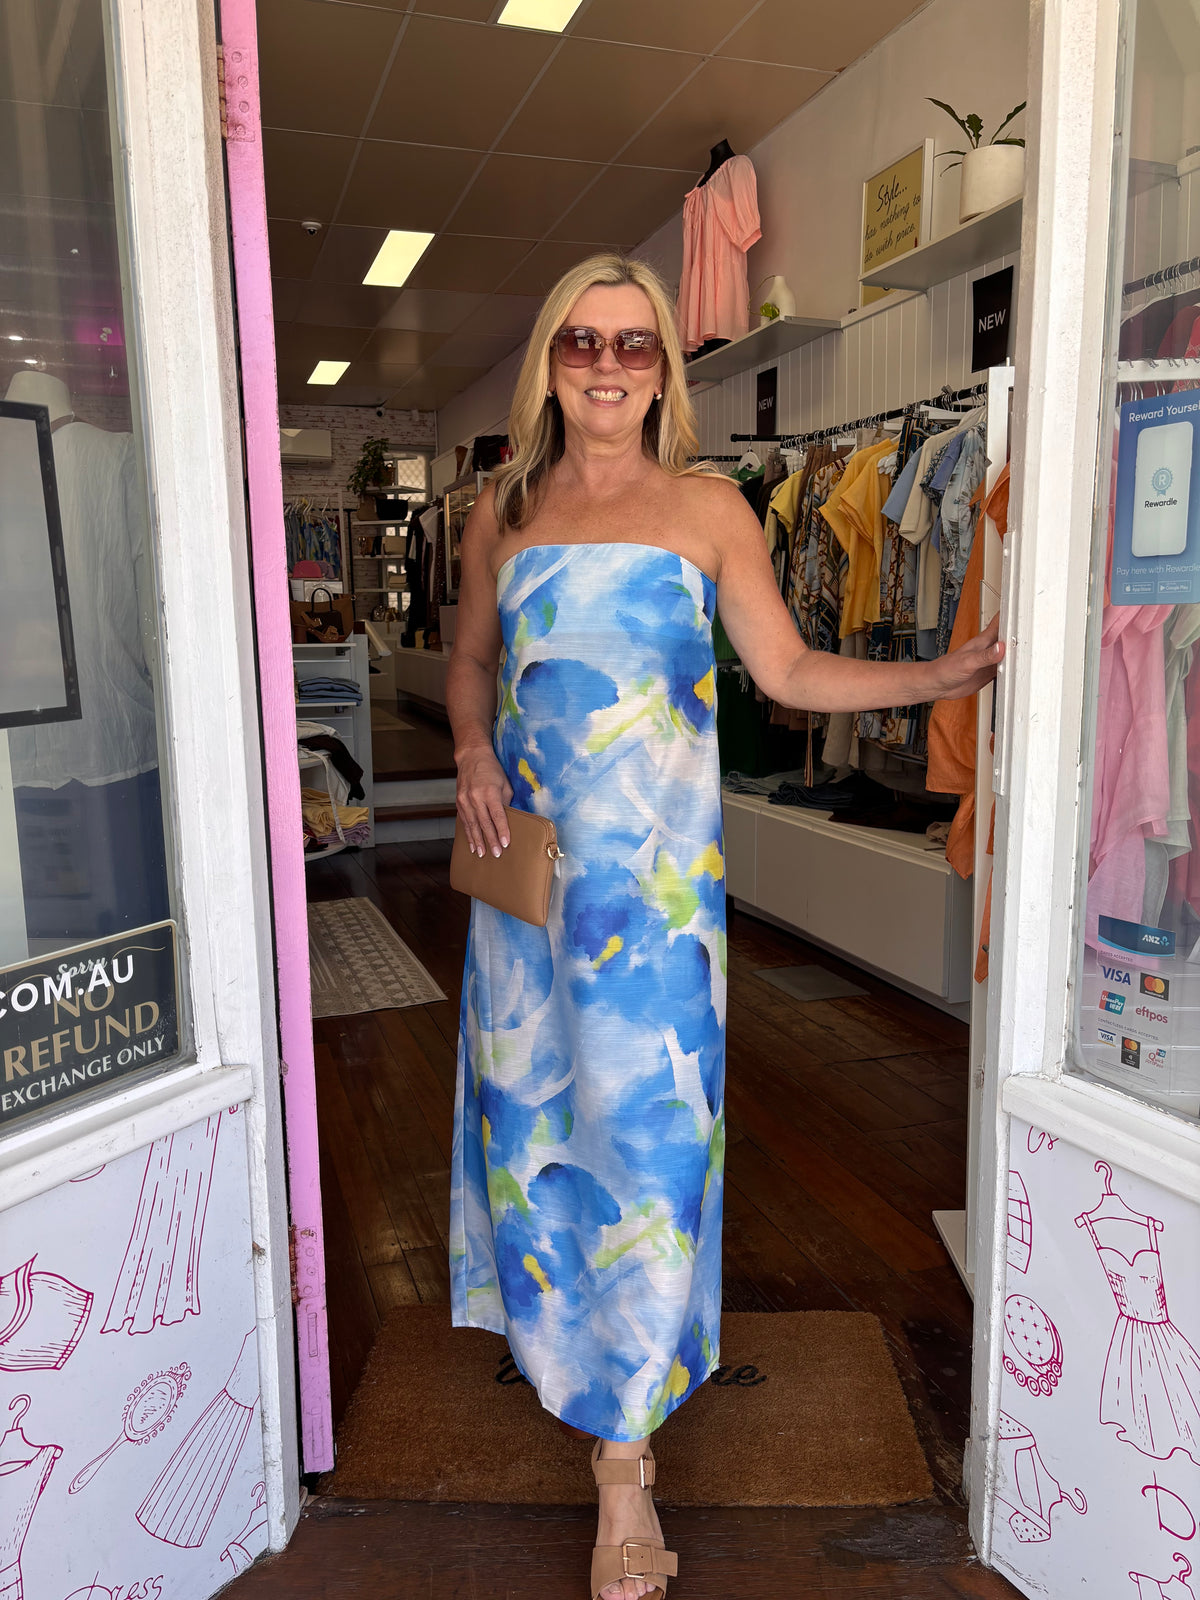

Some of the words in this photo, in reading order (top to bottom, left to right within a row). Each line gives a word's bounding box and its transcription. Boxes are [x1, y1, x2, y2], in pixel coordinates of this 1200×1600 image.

[865, 224, 877, 241] has
[880, 201, 910, 230] nothing
[912, 194, 922, 207] to
[864, 247, 873, 264] do
[876, 231, 893, 257] with
[978, 309, 1007, 333] NEW
[758, 396, 774, 411] NEW
[1128, 406, 1164, 423] Reward
[1144, 497, 1178, 509] Rewardle
[1116, 567, 1130, 576] Pay
[1131, 566, 1147, 575] here
[1149, 564, 1164, 574] with
[1141, 934, 1161, 945] ANZ
[1101, 965, 1131, 986] VISA
[0, 955, 133, 1019] OM.AU
[53, 980, 115, 1025] NO
[1135, 1006, 1168, 1024] eftpos
[3, 1001, 160, 1082] REFUND
[1100, 1032, 1113, 1042] VISA
[1, 1055, 112, 1112] EXCHANGE
[116, 1034, 165, 1066] ONLY
